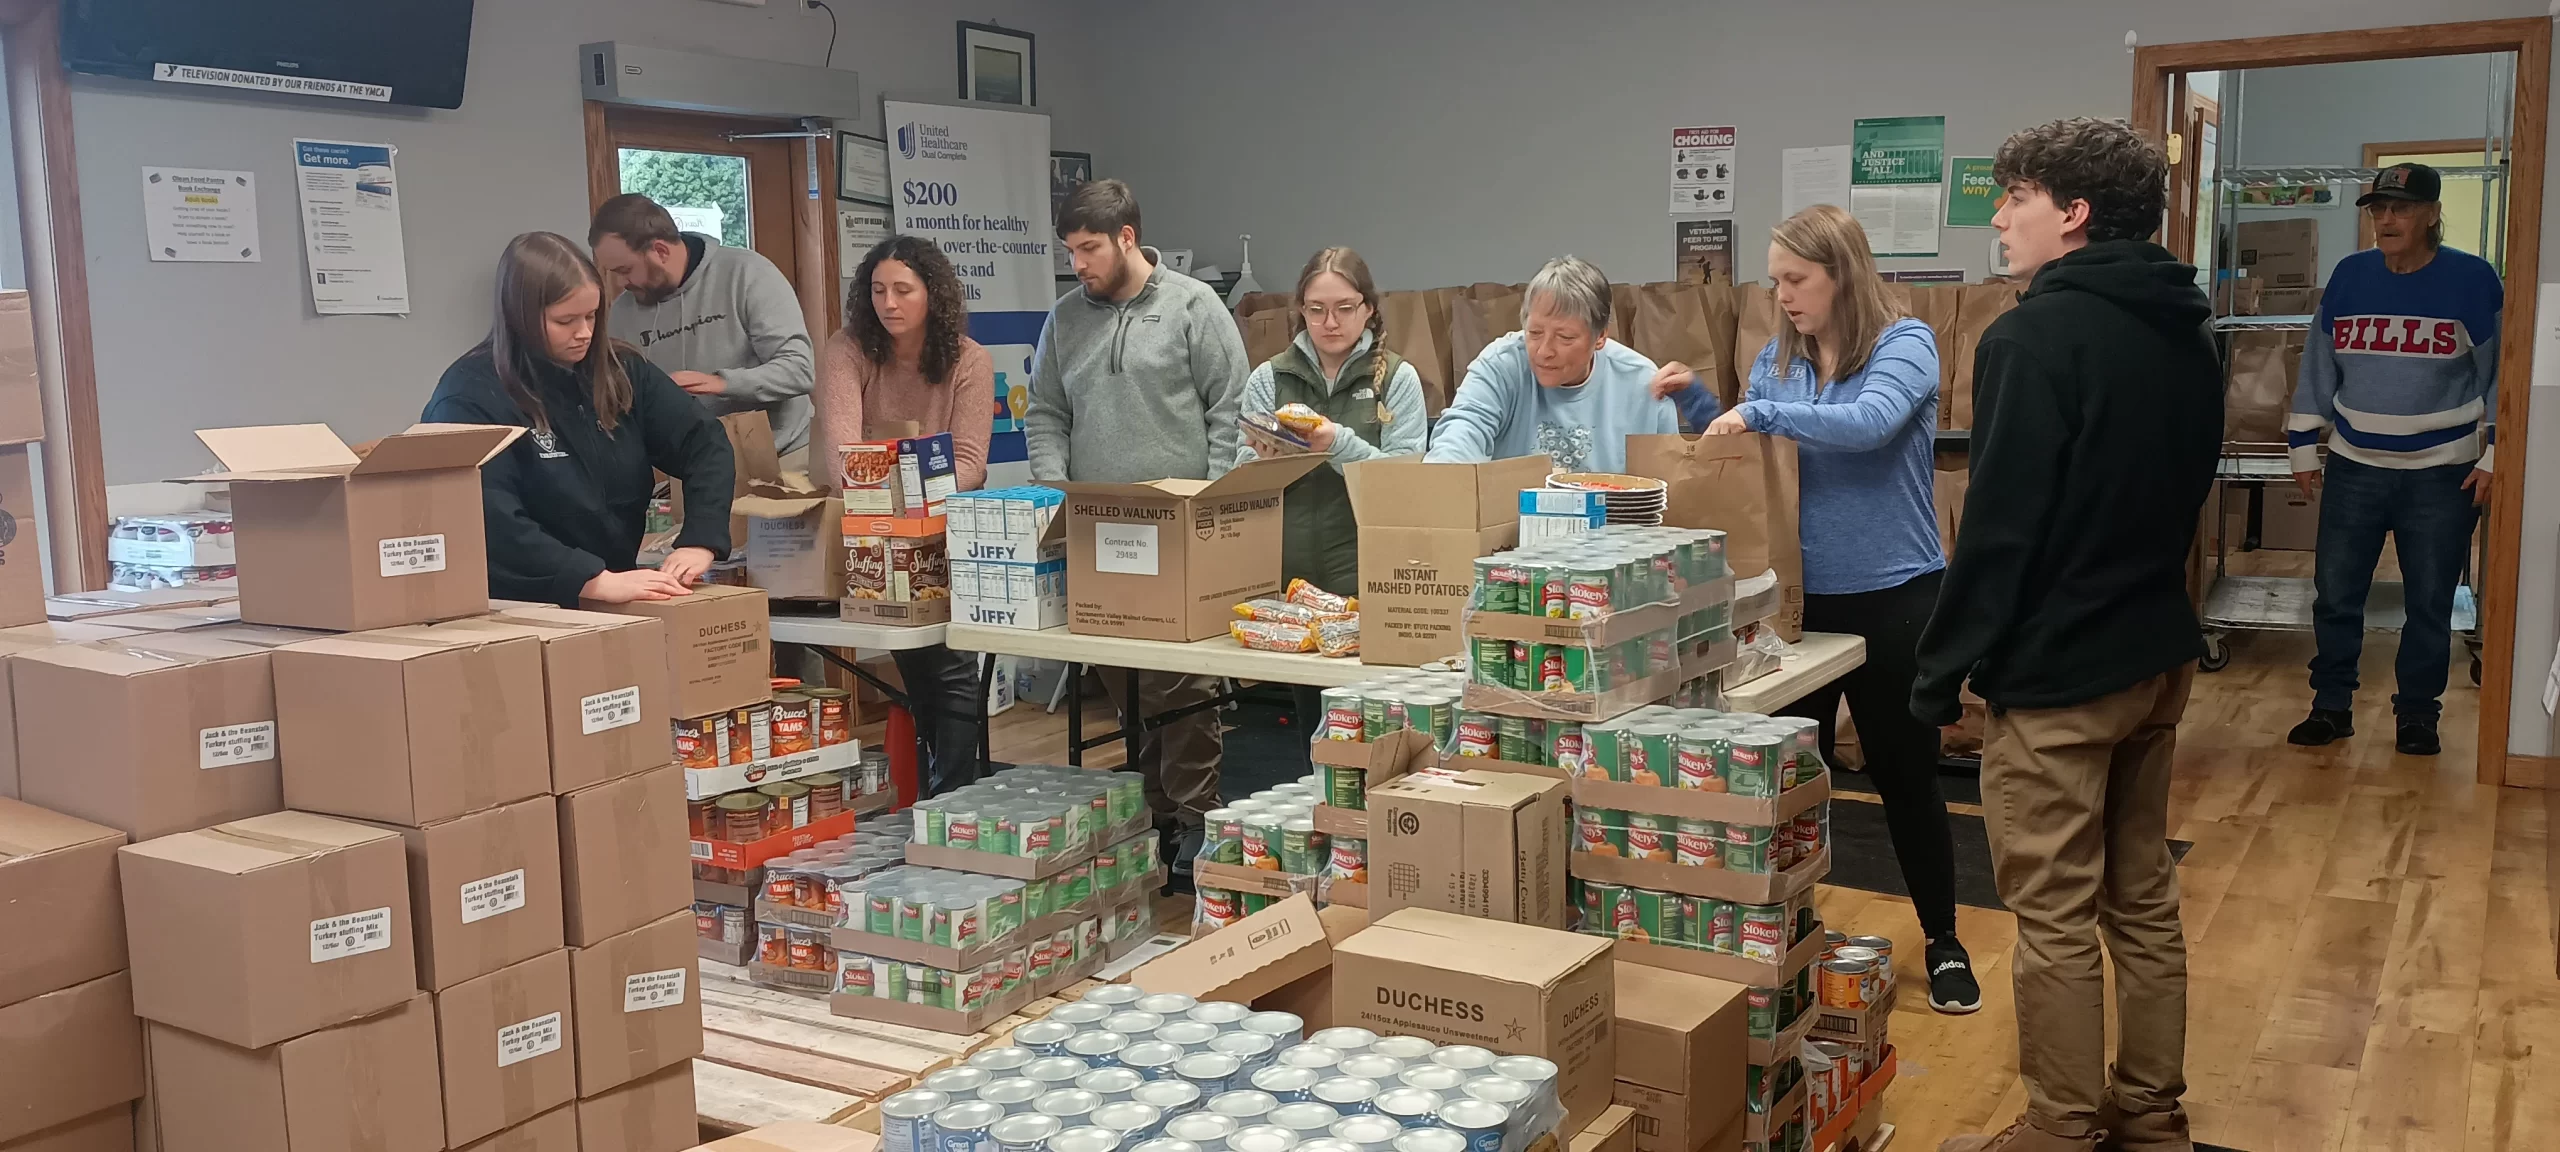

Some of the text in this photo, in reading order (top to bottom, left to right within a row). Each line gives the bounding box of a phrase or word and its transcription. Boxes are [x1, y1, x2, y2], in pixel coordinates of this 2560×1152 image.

[181, 67, 386, 97] TELEVISION DONATED BY OUR FRIENDS AT THE YMCA
[919, 123, 949, 138] United
[920, 137, 968, 151] Healthcare
[1674, 134, 1734, 146] CHOKING
[303, 153, 352, 166] Get more.
[921, 150, 967, 162] Dual Complete
[1861, 157, 1906, 167] JUSTICE
[1862, 150, 1885, 159] AND
[1872, 166, 1893, 175] ALL
[903, 178, 958, 208] $200
[1962, 186, 1991, 198] wny
[905, 214, 1030, 235] a month for healthy
[1689, 227, 1723, 235] VETERANS
[943, 237, 1048, 255] over-the-counter
[1689, 244, 1723, 252] PROGRAM
[970, 261, 995, 277] and
[639, 313, 727, 348] Champion
[2333, 317, 2457, 355] BILLS
[1074, 504, 1176, 521] SHELLED WALNUTS
[1220, 496, 1280, 515] SHELLED WALNUTS
[1104, 537, 1149, 548] Contract No.
[845, 548, 884, 579] Stuffing
[909, 549, 946, 574] Stuffing
[1393, 568, 1439, 582] INSTANT
[1367, 581, 1470, 597] MASHED POTATOES
[699, 620, 747, 638] DUCHESS
[771, 705, 807, 722] Bruce's
[777, 721, 804, 733] YAMS
[314, 912, 384, 931] Jack & the Beanstalk
[314, 931, 337, 941] Turkey
[338, 925, 364, 937] stuffing
[1933, 959, 1966, 976] adidas
[1376, 985, 1485, 1023] DUCHESS
[1563, 992, 1600, 1029] DUCHESS
[1360, 1011, 1392, 1024] 24/15oz
[1392, 1017, 1441, 1034] Applesauce
[1443, 1027, 1500, 1044] Unsweetened
